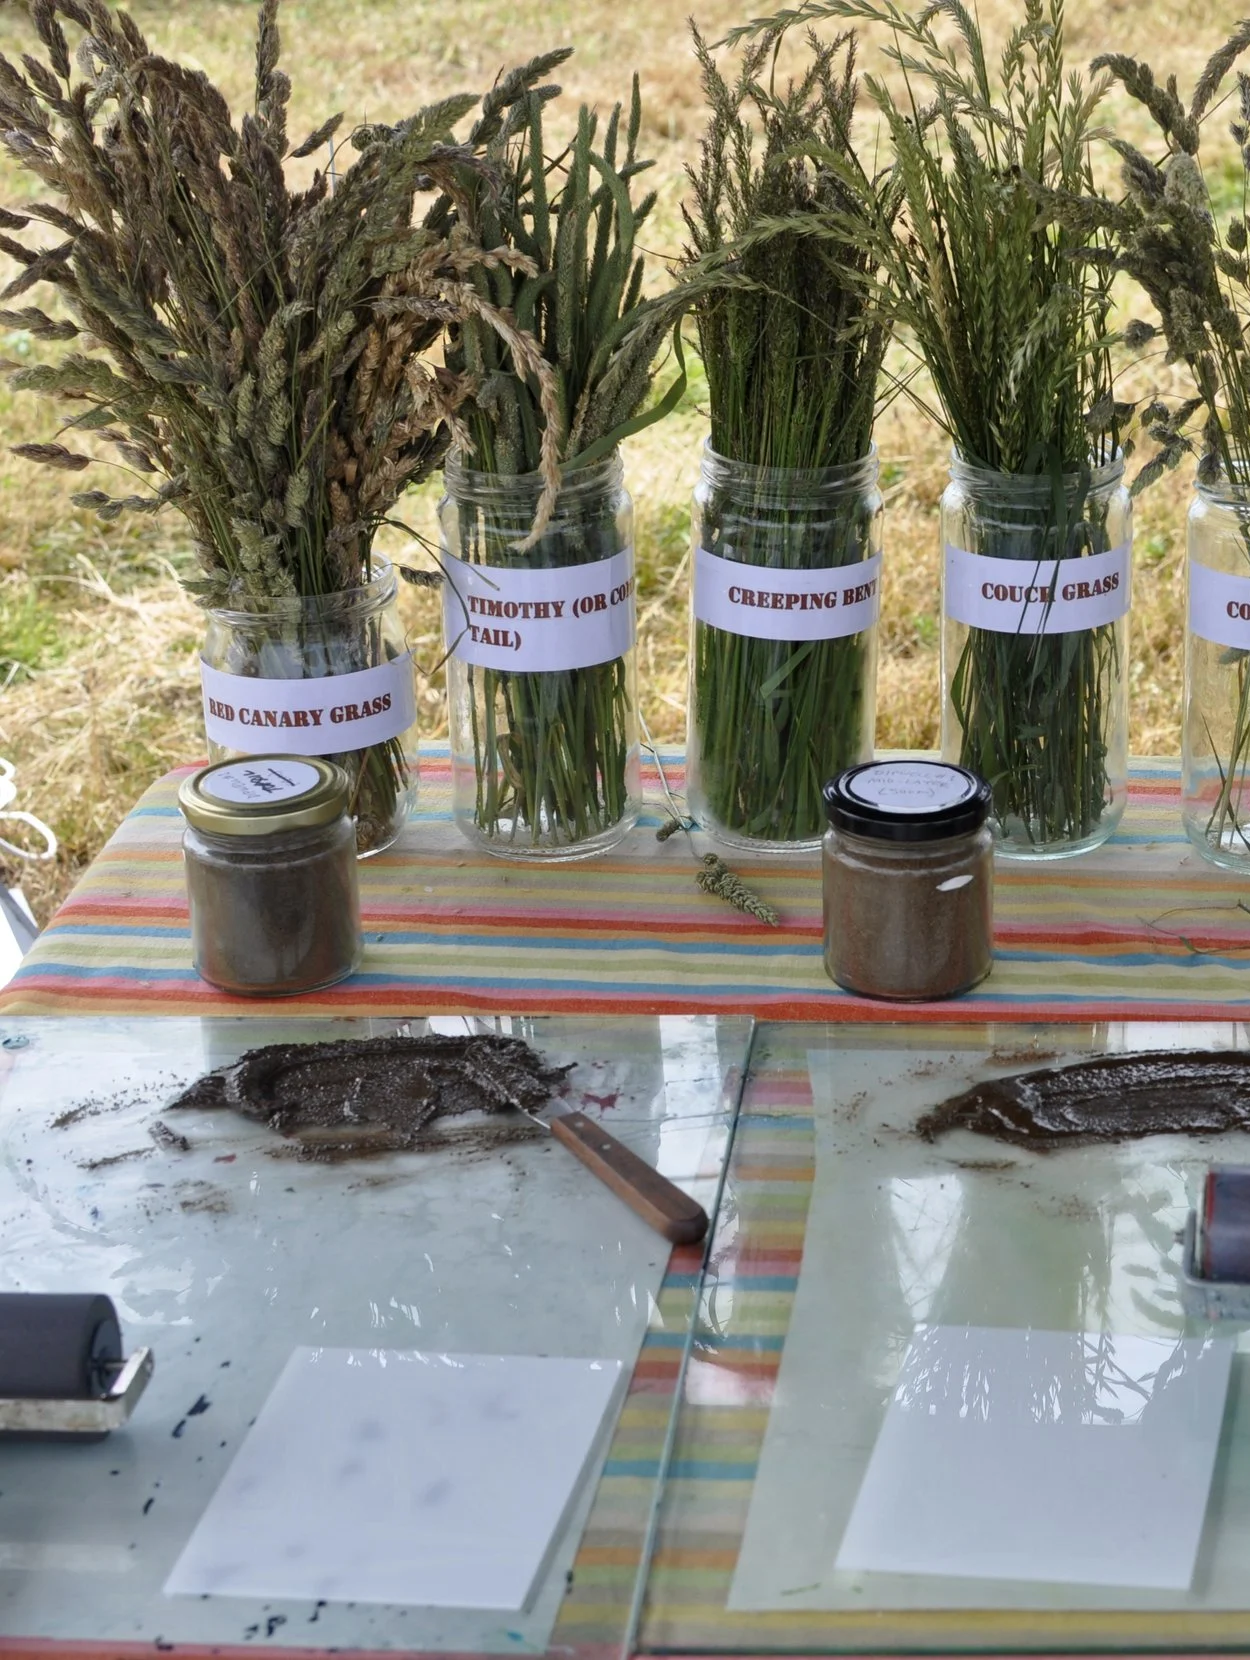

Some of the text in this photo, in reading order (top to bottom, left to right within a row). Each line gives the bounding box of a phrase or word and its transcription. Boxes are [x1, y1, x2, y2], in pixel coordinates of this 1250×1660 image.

[728, 577, 878, 610] CREEPING BENT
[1062, 571, 1120, 601] GRASS
[467, 595, 566, 619] TIMOTHY
[572, 593, 608, 619] (OR
[468, 624, 522, 651] TAIL)
[208, 692, 392, 728] RED CANARY GRASS
